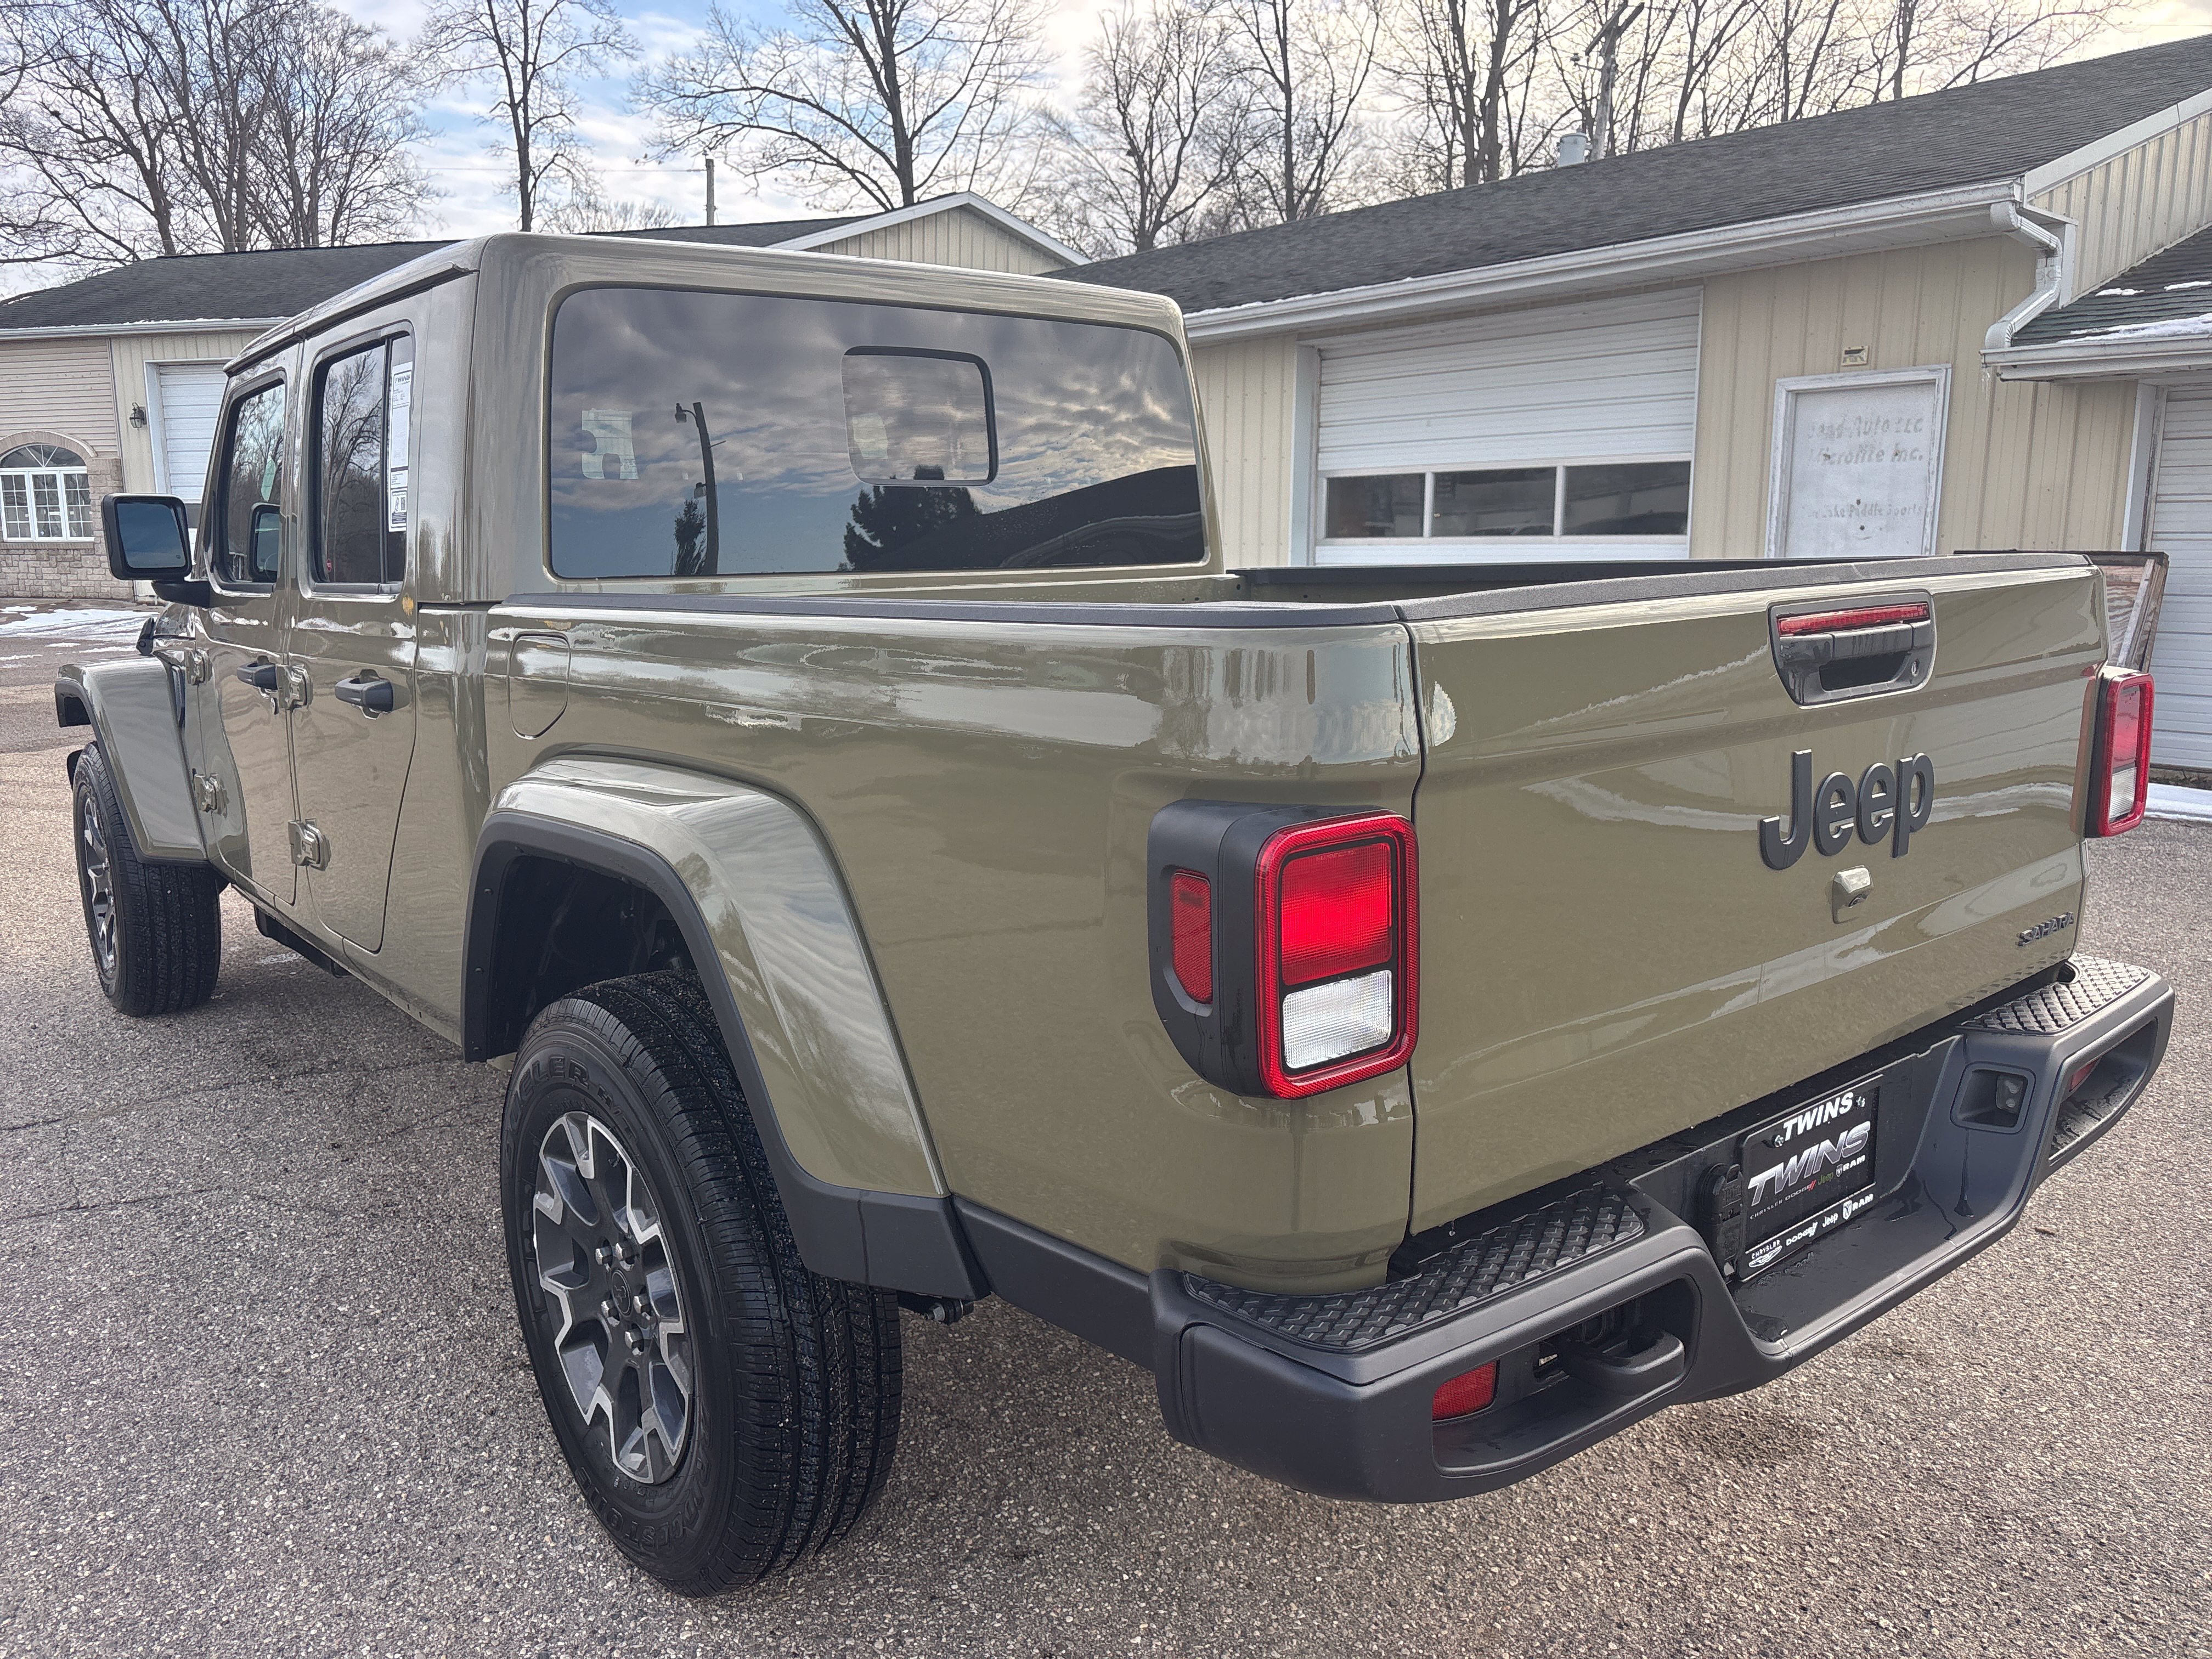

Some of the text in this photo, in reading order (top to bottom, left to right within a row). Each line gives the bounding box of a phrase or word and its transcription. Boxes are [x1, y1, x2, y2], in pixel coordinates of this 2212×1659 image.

[1759, 748, 1935, 870] Jeep
[2016, 911, 2074, 947] SAHARA
[1783, 1092, 1854, 1141] TWINS
[1748, 1120, 1871, 1207] TWINS
[1750, 1154, 1865, 1220] CHRYSLER DODGE Jeep RAM
[1751, 1193, 1874, 1260] CHRYSLER DODGE Jeep RAM
